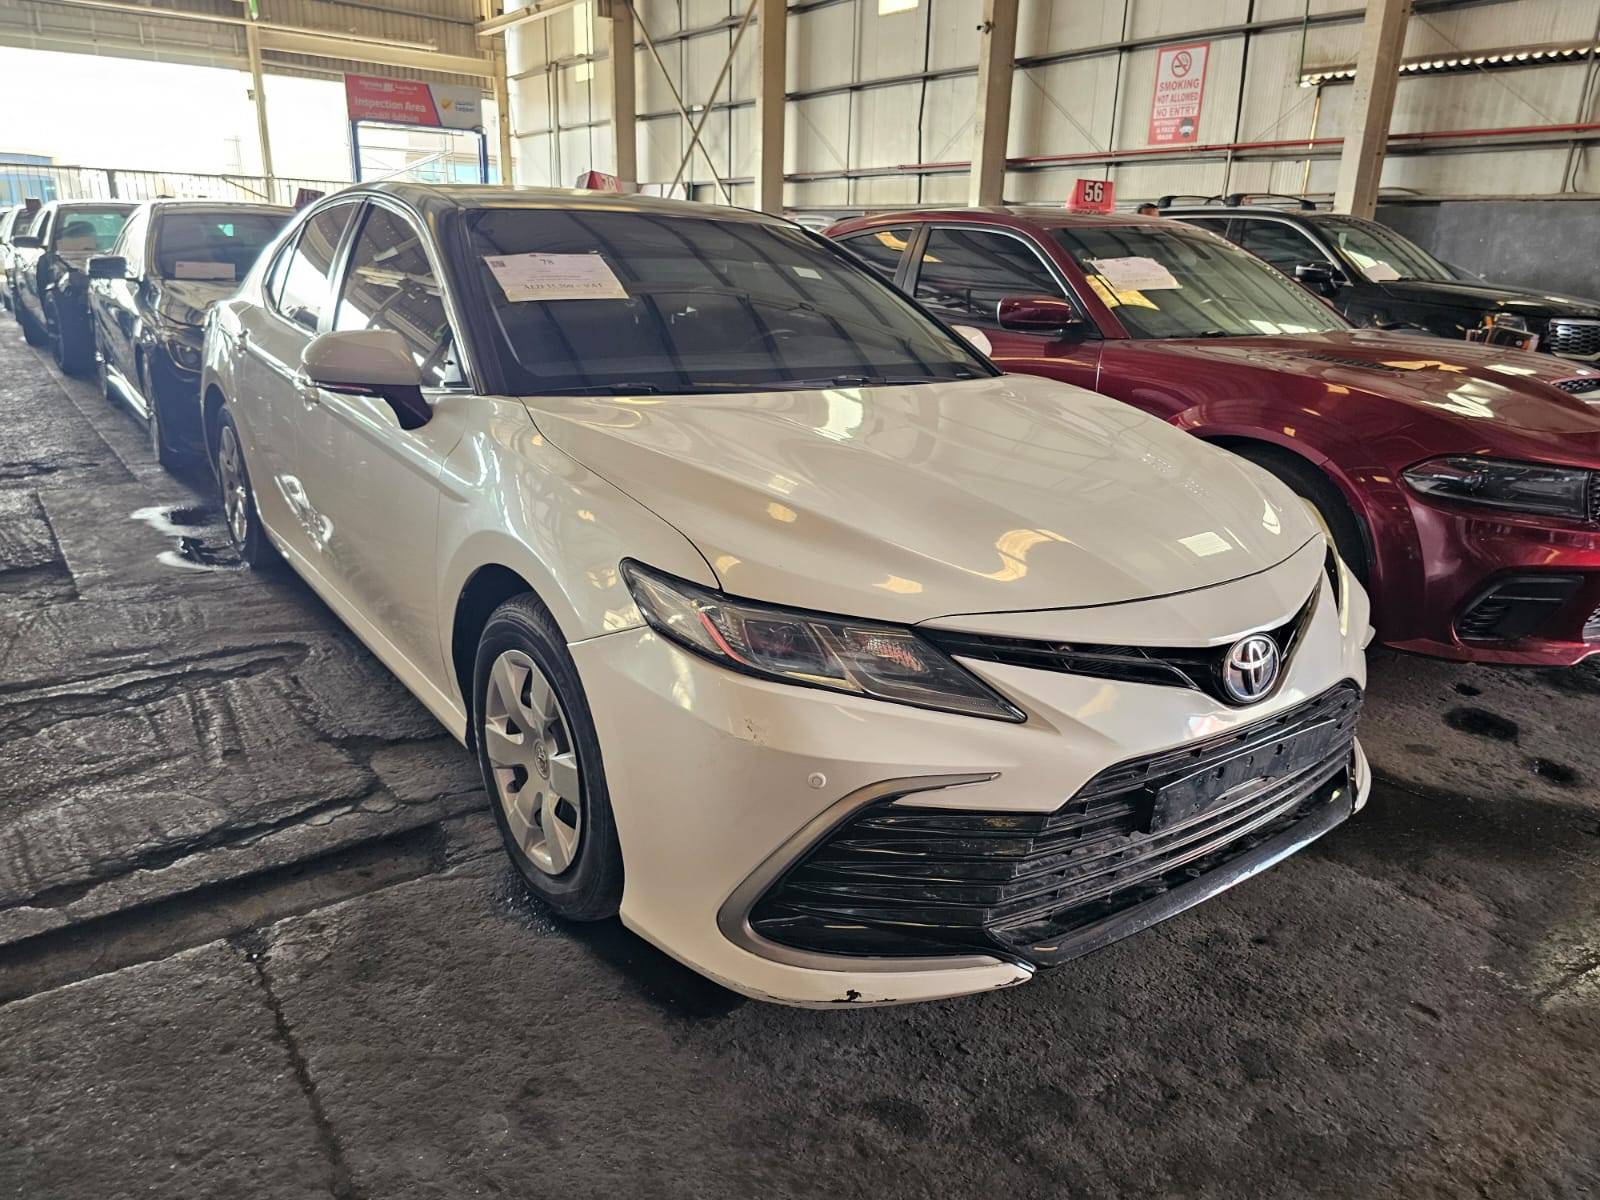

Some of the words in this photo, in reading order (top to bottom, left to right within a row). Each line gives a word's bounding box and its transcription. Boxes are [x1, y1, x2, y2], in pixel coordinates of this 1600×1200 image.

[1160, 79, 1199, 92] SMOKING
[355, 96, 403, 110] Inspection
[405, 101, 426, 113] Area
[1157, 94, 1169, 104] NOT
[1170, 92, 1199, 102] ALLOWED
[1156, 107, 1168, 117] NO
[1170, 105, 1196, 116] ENTRY
[1084, 181, 1104, 203] 56
